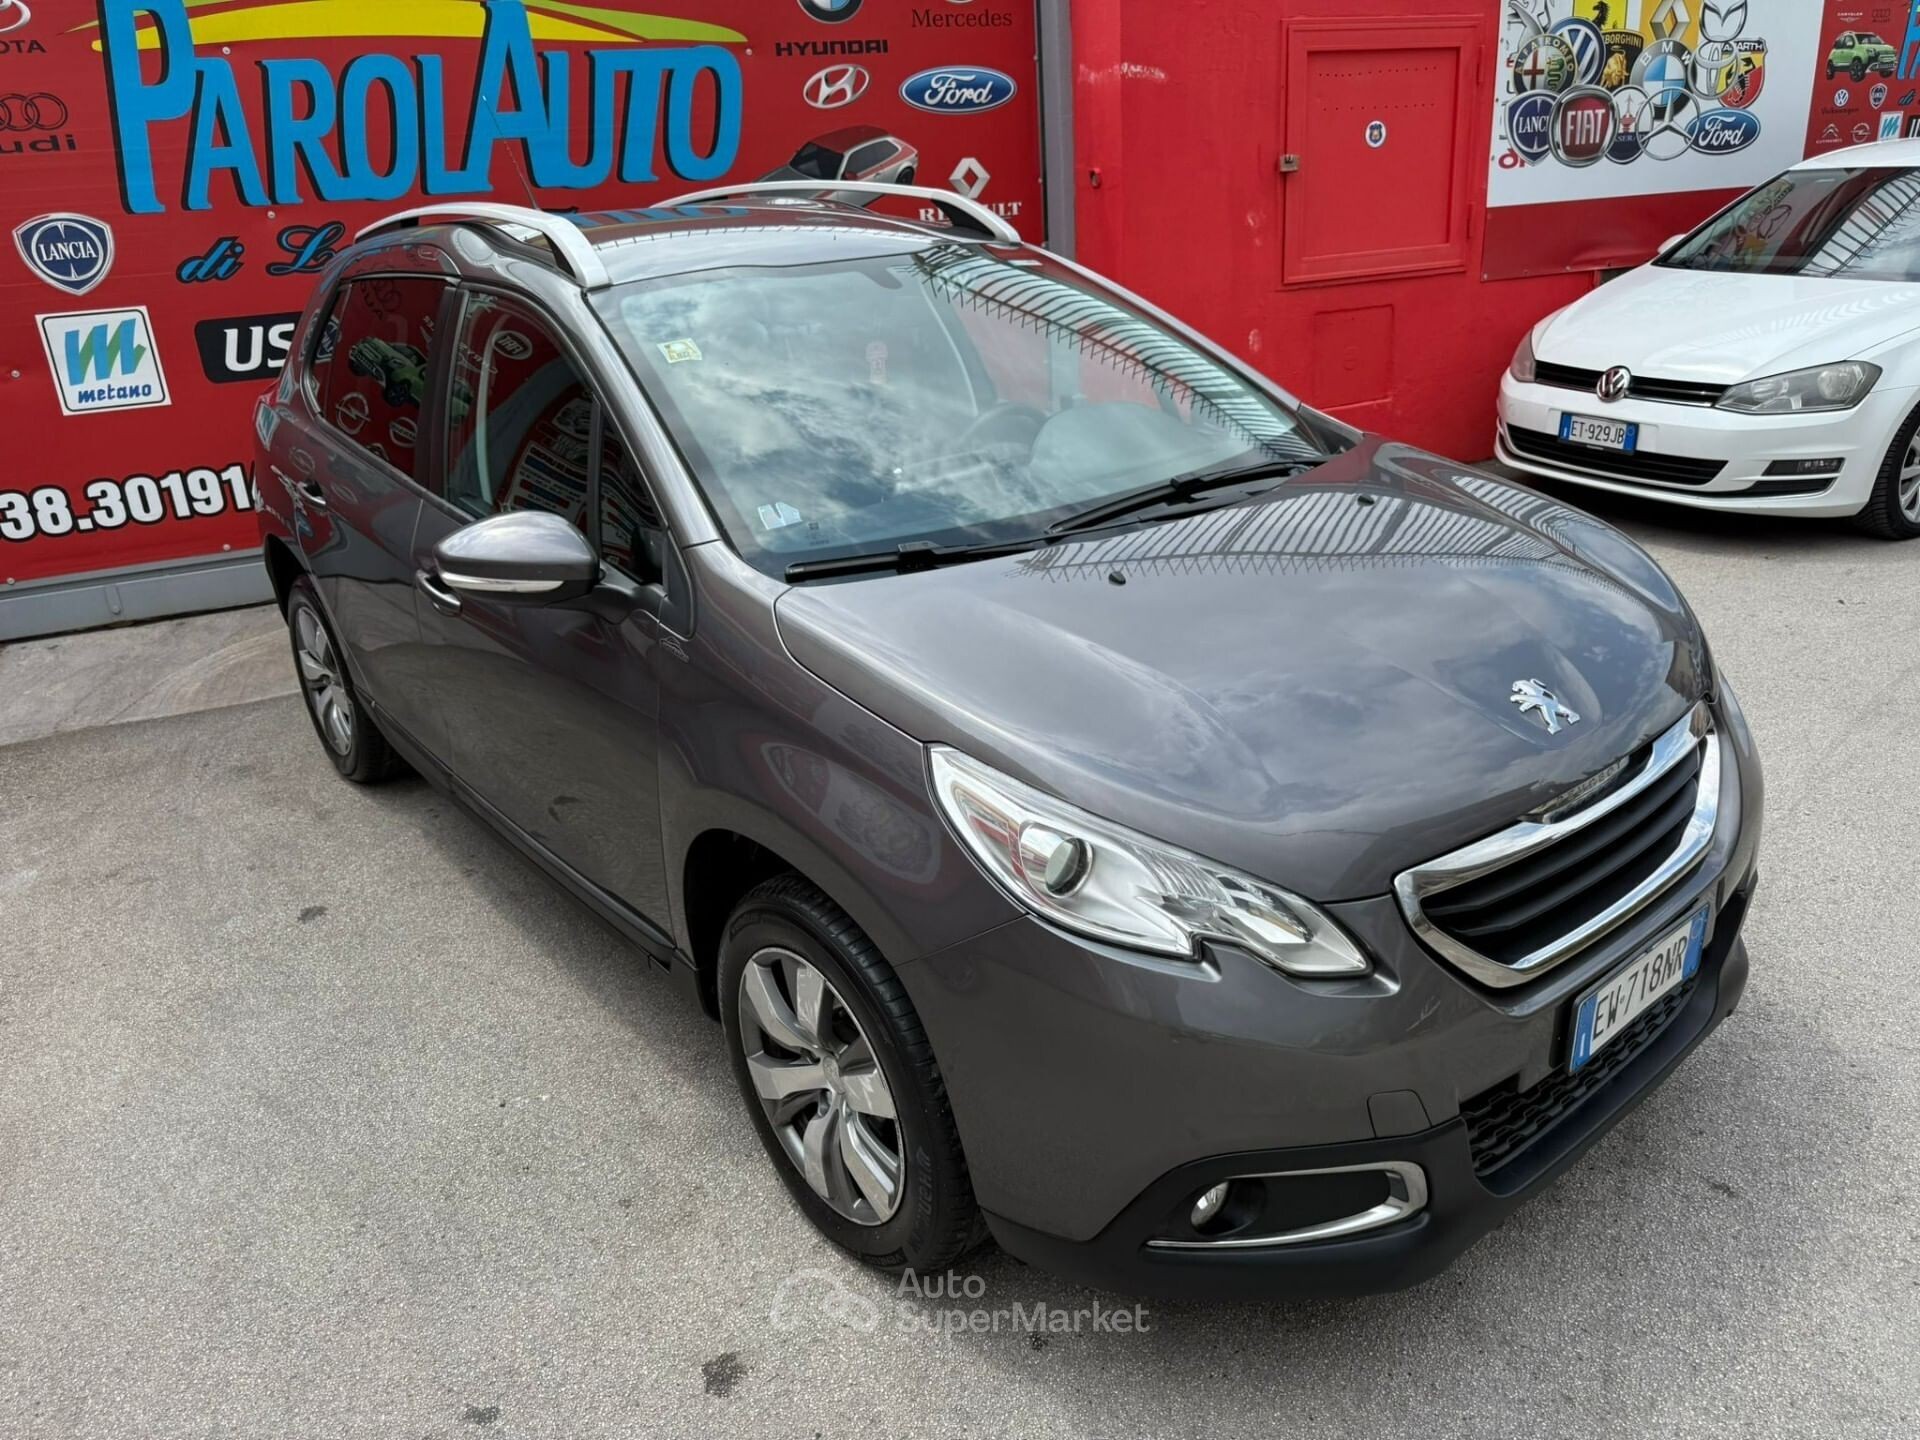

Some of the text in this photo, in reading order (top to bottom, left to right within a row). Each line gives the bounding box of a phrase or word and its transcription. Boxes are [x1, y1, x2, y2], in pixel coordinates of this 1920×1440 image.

[911, 9, 1012, 28] Mercedes
[776, 39, 888, 56] HYUNDAI
[1722, 41, 1763, 52] AARTH
[924, 73, 993, 104] Ford
[1518, 115, 1549, 133] LANCI
[1565, 108, 1606, 146] FIAT
[1698, 115, 1747, 147] Ford
[38, 241, 98, 262] LANCIA
[177, 236, 246, 283] di
[223, 322, 295, 372] US
[78, 383, 152, 404] metano
[0, 464, 256, 540] 38.30191
